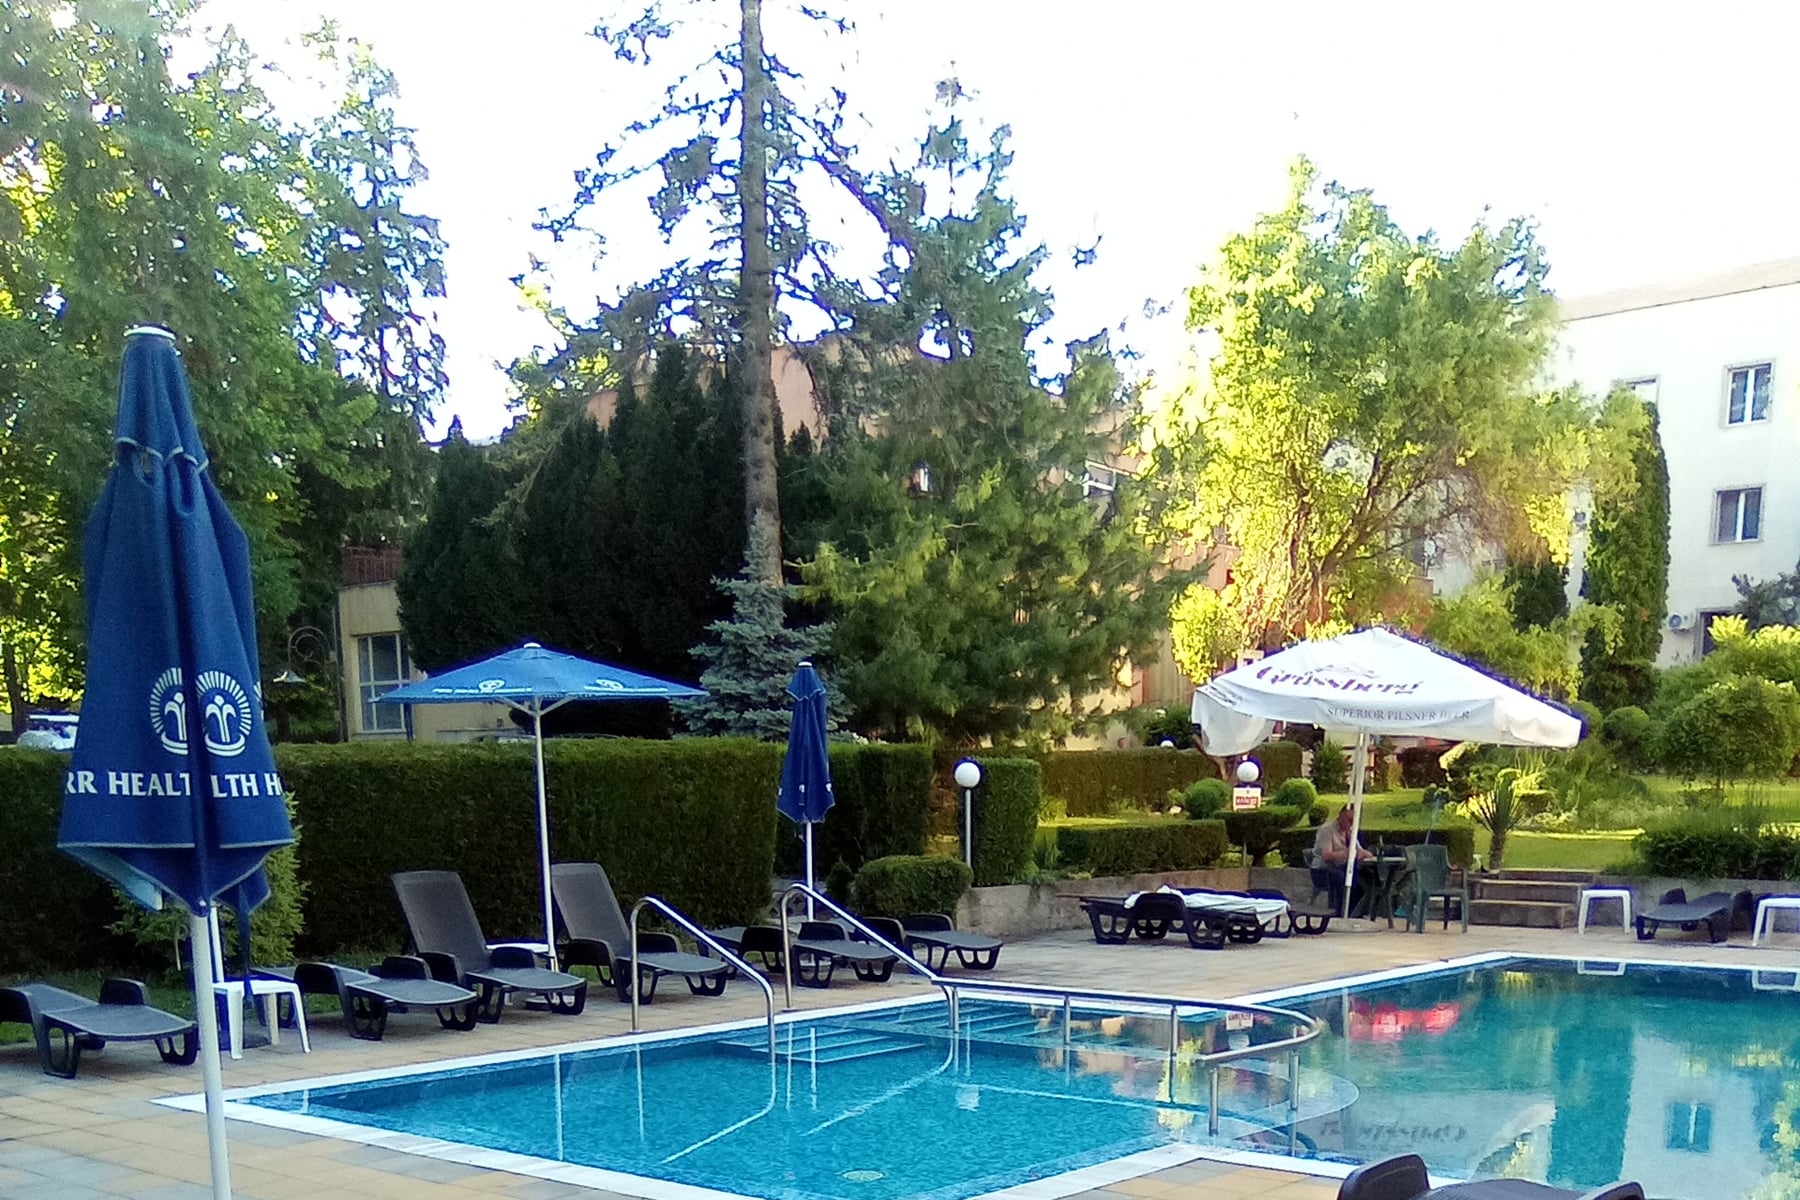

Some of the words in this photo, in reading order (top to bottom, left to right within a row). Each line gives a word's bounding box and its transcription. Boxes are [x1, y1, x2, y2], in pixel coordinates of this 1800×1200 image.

[1328, 708, 1385, 721] SUPERIOR
[1387, 710, 1437, 721] PILSNER
[107, 771, 191, 797] HEALT
[210, 773, 260, 798] LTH
[263, 773, 283, 796] H
